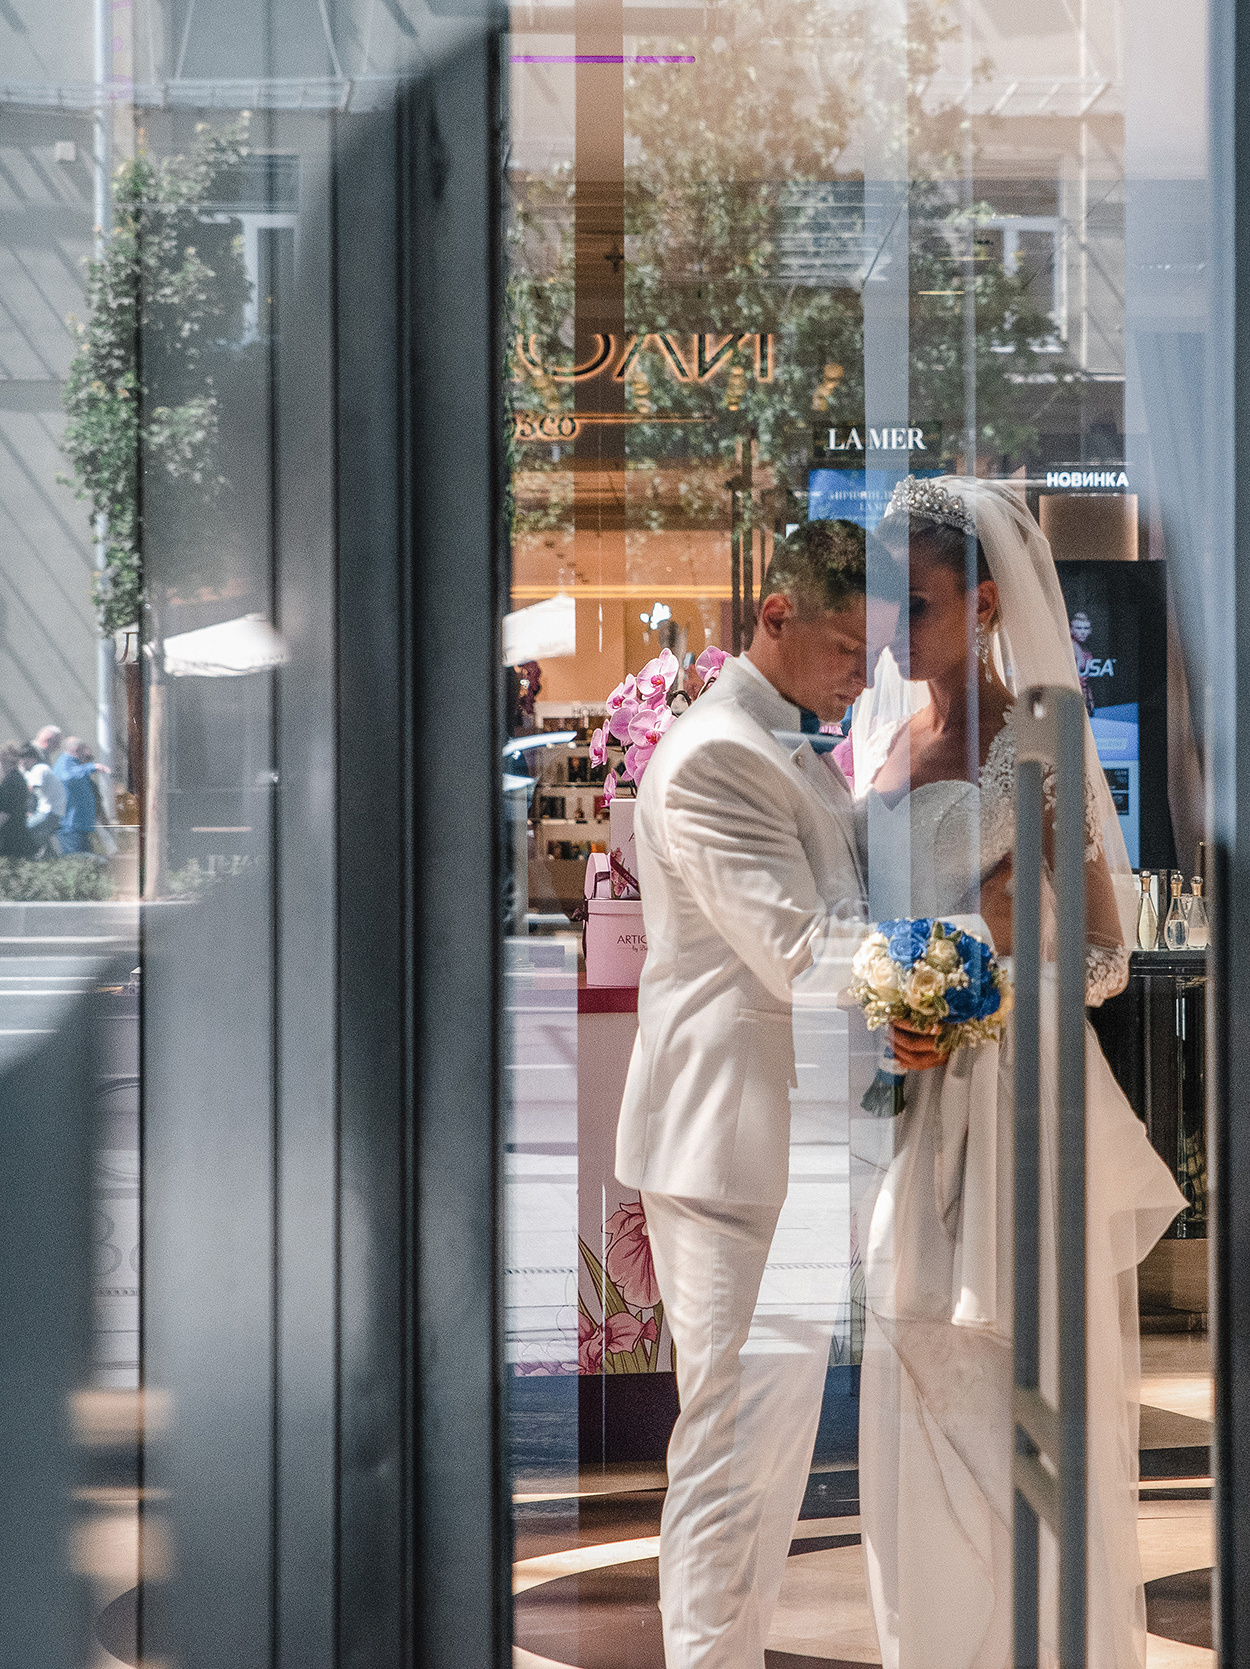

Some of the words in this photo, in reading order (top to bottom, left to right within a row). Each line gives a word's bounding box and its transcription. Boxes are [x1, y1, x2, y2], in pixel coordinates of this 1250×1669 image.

[828, 427, 863, 450] LA
[868, 427, 928, 450] MER
[1046, 472, 1130, 488] НОВИНКА
